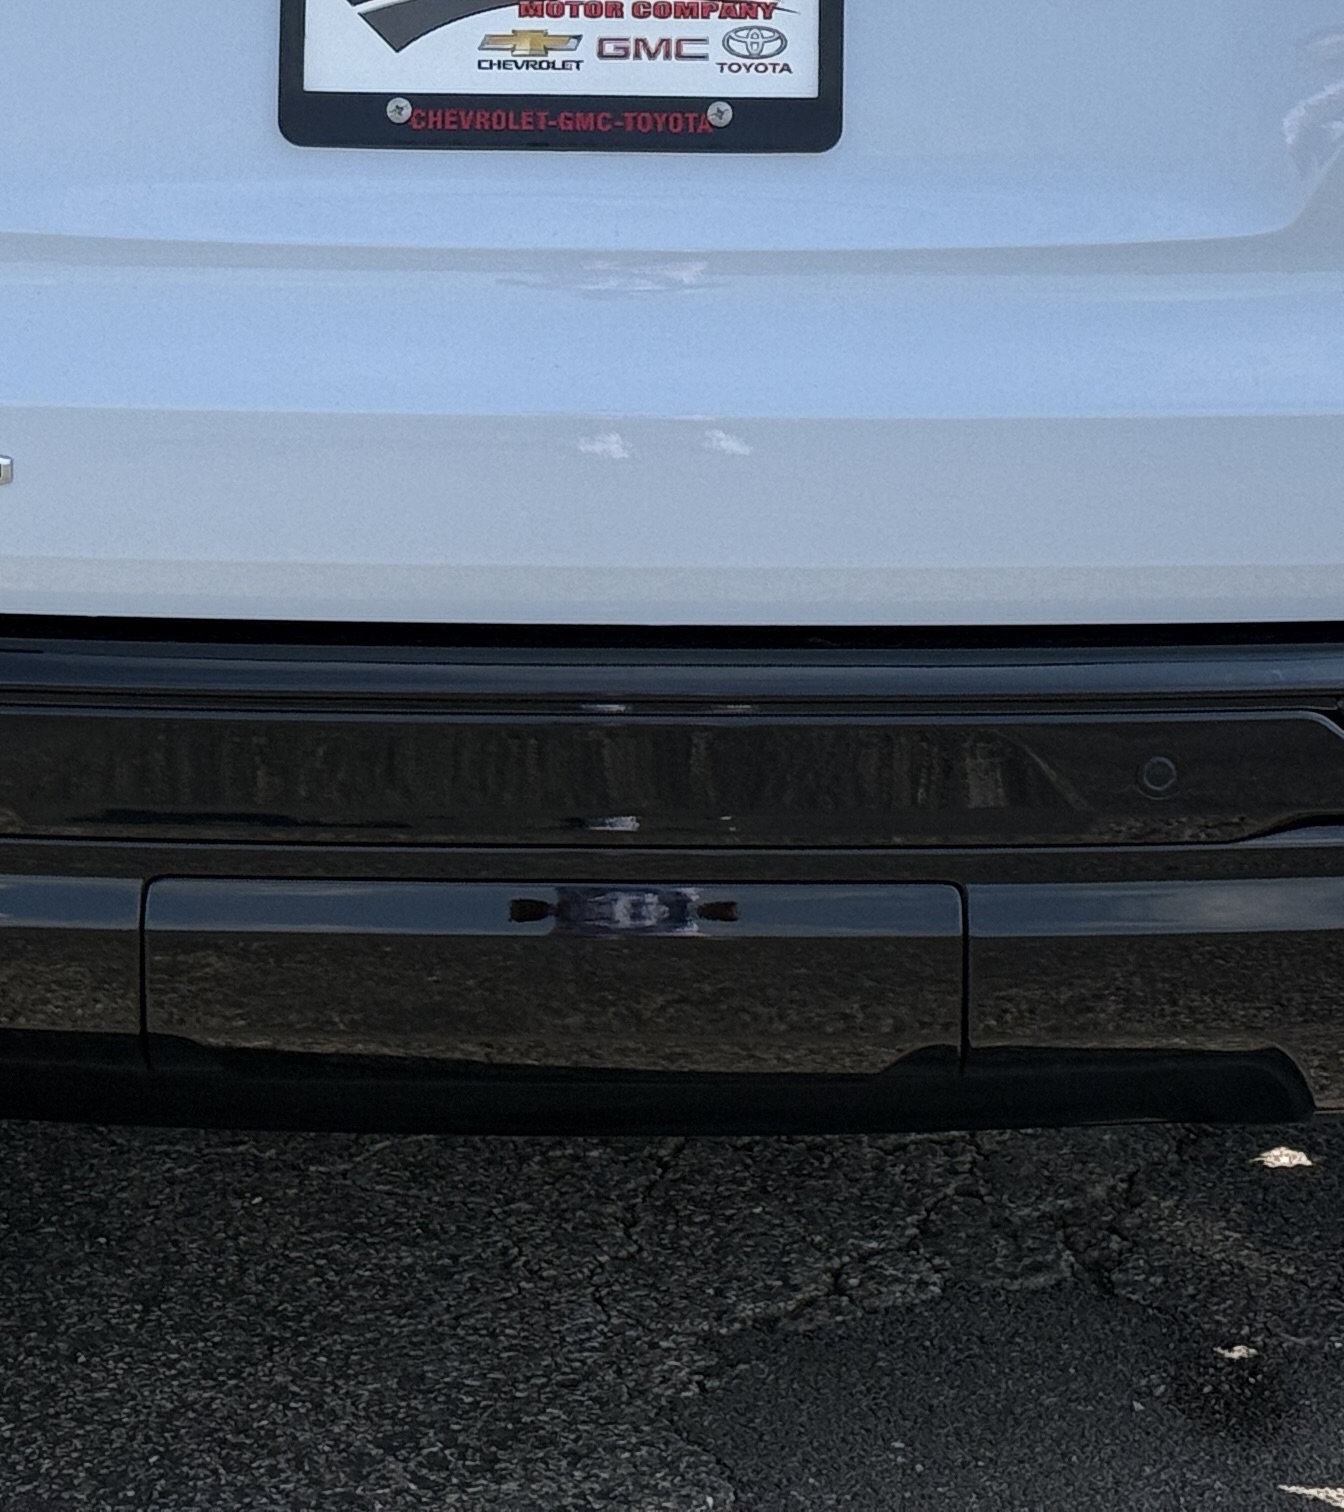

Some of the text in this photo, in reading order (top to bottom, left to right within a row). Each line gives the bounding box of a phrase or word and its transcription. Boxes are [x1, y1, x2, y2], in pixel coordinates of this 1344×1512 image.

[518, 0, 778, 20] MOTOR COMPANY
[596, 36, 711, 61] GMC
[477, 59, 585, 72] CHEVROLET
[715, 62, 794, 74] TOYOTA
